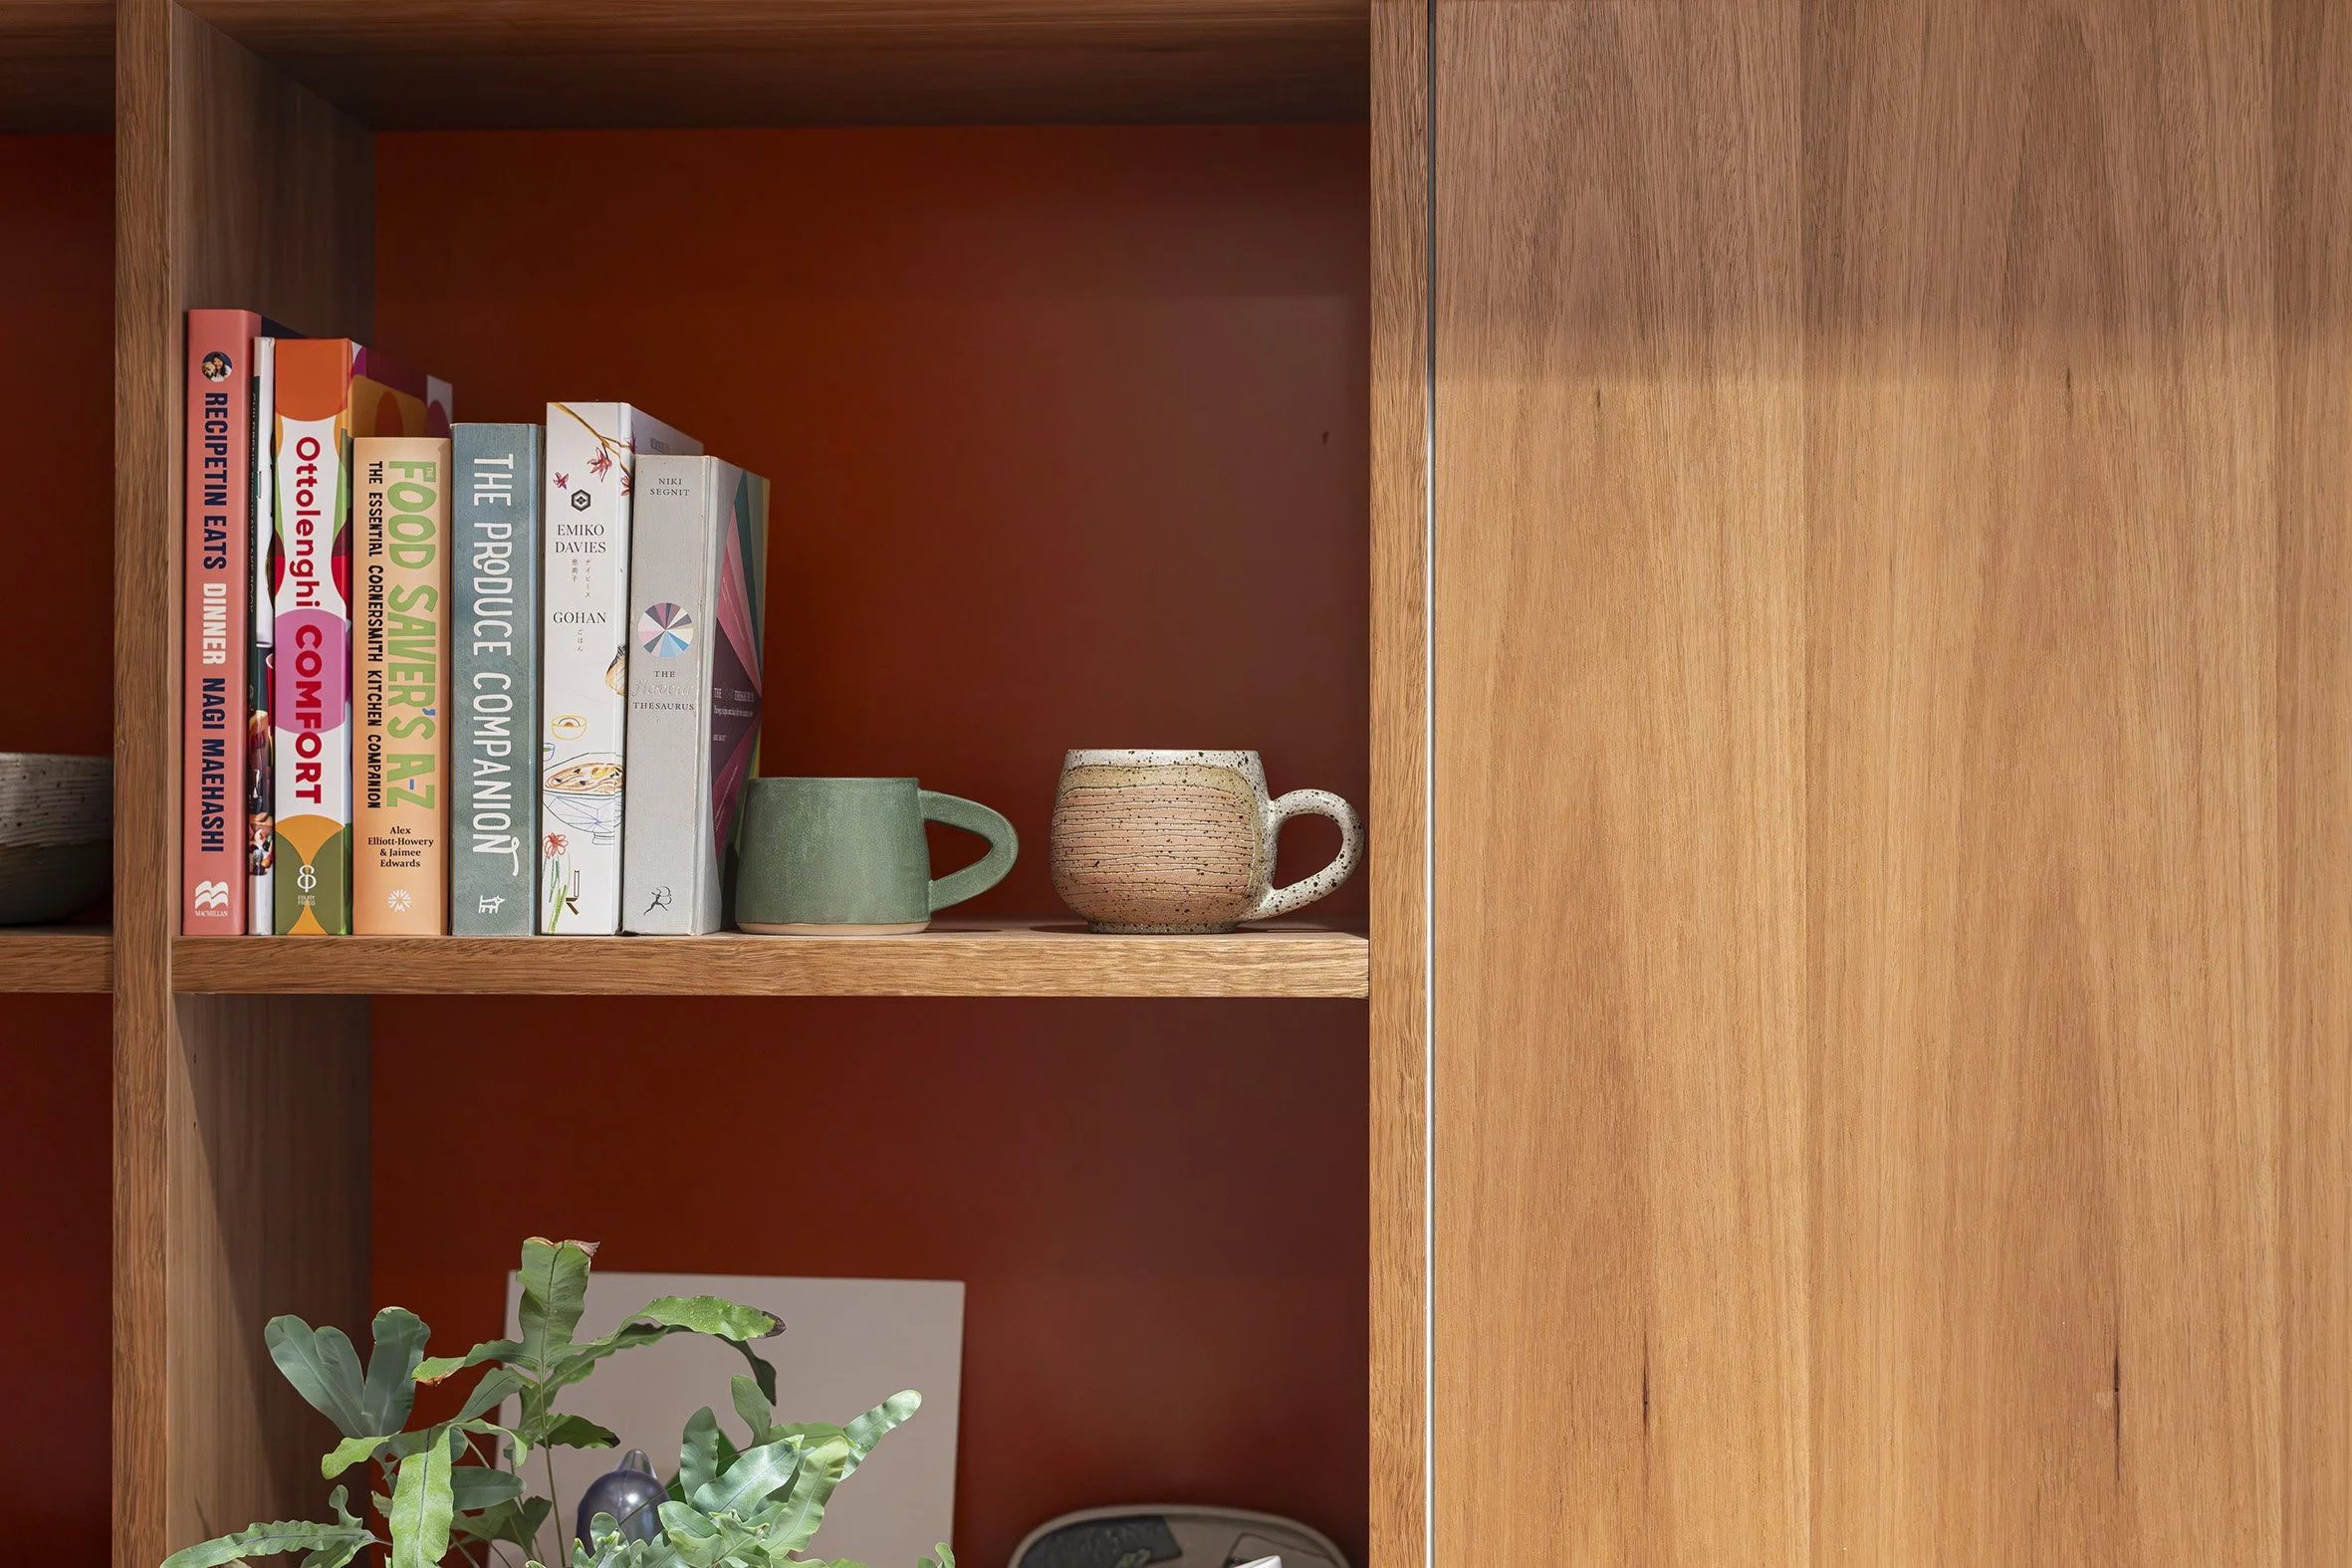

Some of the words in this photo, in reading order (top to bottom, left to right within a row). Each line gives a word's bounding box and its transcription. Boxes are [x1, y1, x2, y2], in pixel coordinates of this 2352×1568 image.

[204, 392, 228, 506] RECIPETIN
[368, 461, 383, 485] THE
[473, 453, 514, 507] THE
[649, 488, 690, 497] SEGNIT
[658, 477, 682, 486] NIKI
[289, 436, 321, 607] Ottolenghi
[368, 492, 383, 558] ESSENTIAL
[386, 461, 437, 568] FOOD
[557, 524, 604, 537] EMIKO
[203, 515, 227, 569] EATS
[555, 541, 606, 554] DAVIES
[367, 564, 383, 662] CORNERSMITH
[473, 522, 514, 656] PRODUCE
[202, 582, 227, 664] DINNER
[553, 611, 606, 624] GOHAN
[386, 584, 439, 740] SAVER'S
[201, 677, 226, 730] NAGI
[295, 624, 323, 804] COMFORT
[366, 670, 382, 727] KITCHEN
[632, 701, 695, 711] THESAURUS
[200, 739, 225, 852] MAEHASHI
[366, 734, 382, 808] COMPANION
[472, 672, 520, 877] COMPANION
[367, 836, 434, 848] Elliott-Howery
[379, 848, 387, 857] &
[388, 848, 421, 857] Jaimee
[389, 825, 411, 835] Alex
[380, 858, 421, 868] Edwards
